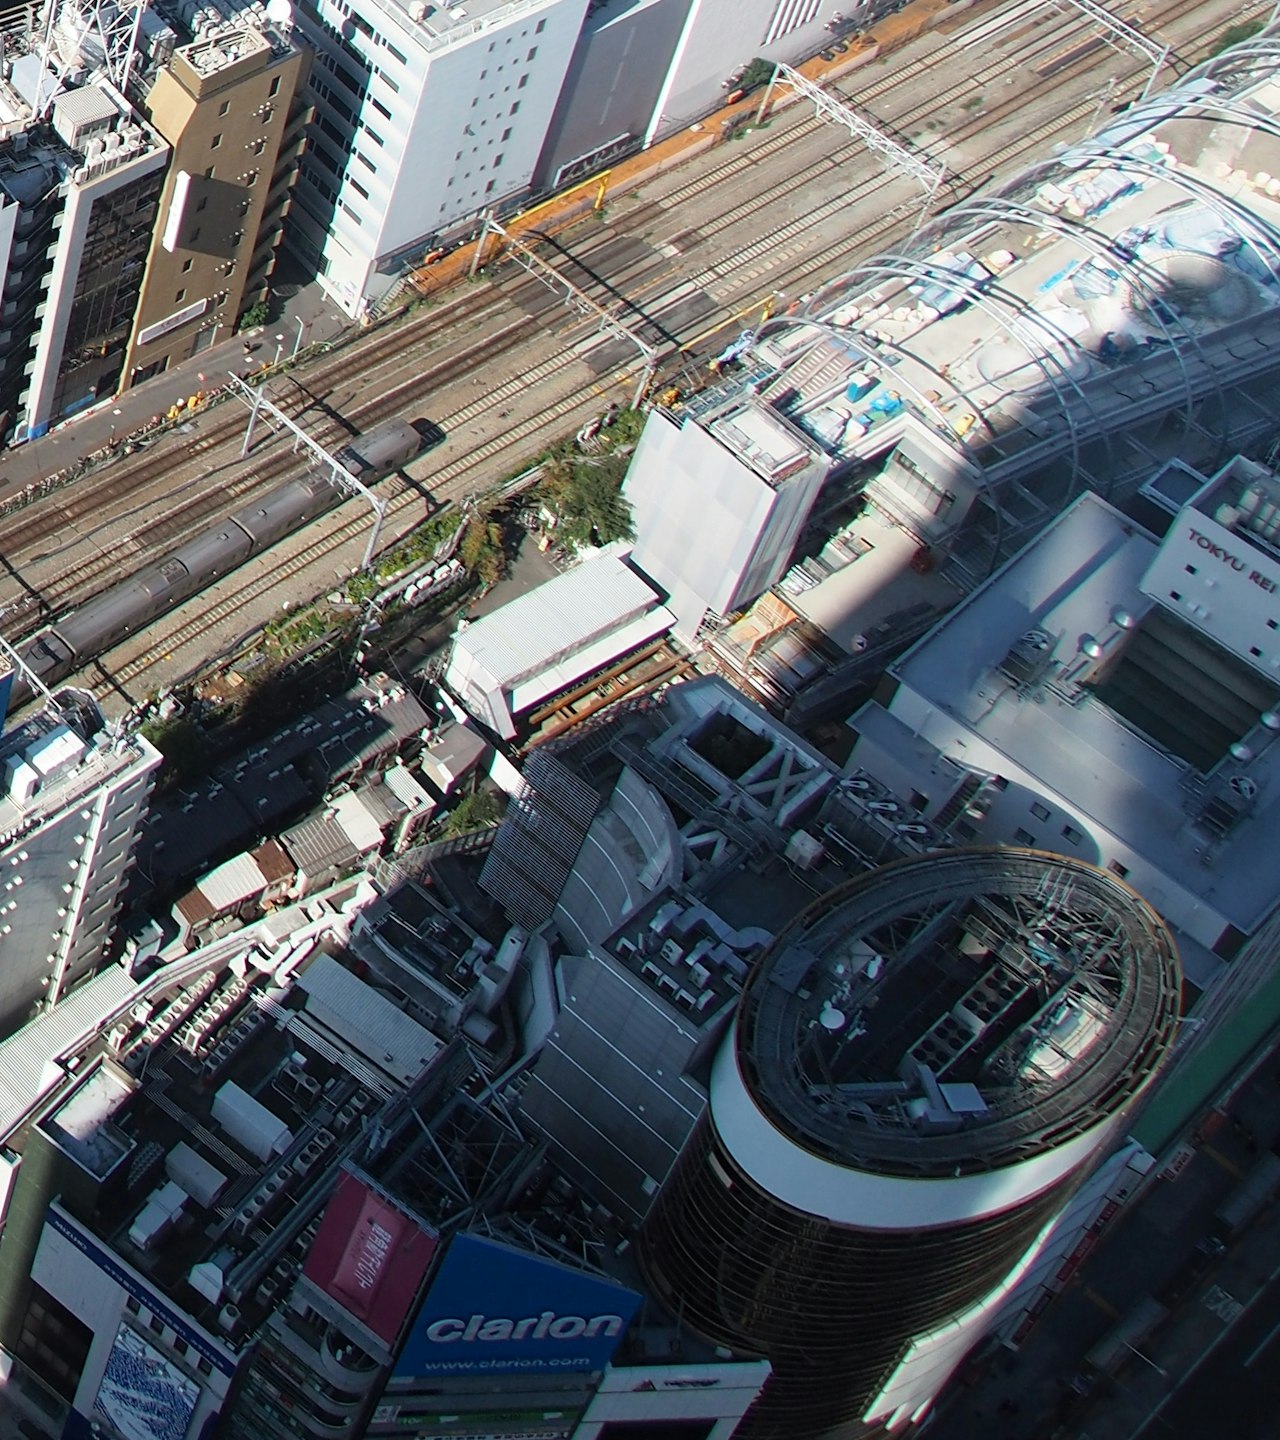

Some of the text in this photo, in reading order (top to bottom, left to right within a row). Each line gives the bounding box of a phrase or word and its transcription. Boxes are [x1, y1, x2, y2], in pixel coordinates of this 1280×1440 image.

[1188, 527, 1277, 595] TOKYU REI
[54, 1219, 88, 1251] MIZUHO
[426, 1309, 622, 1343] clarion
[424, 1355, 591, 1371] www.clarion.com
